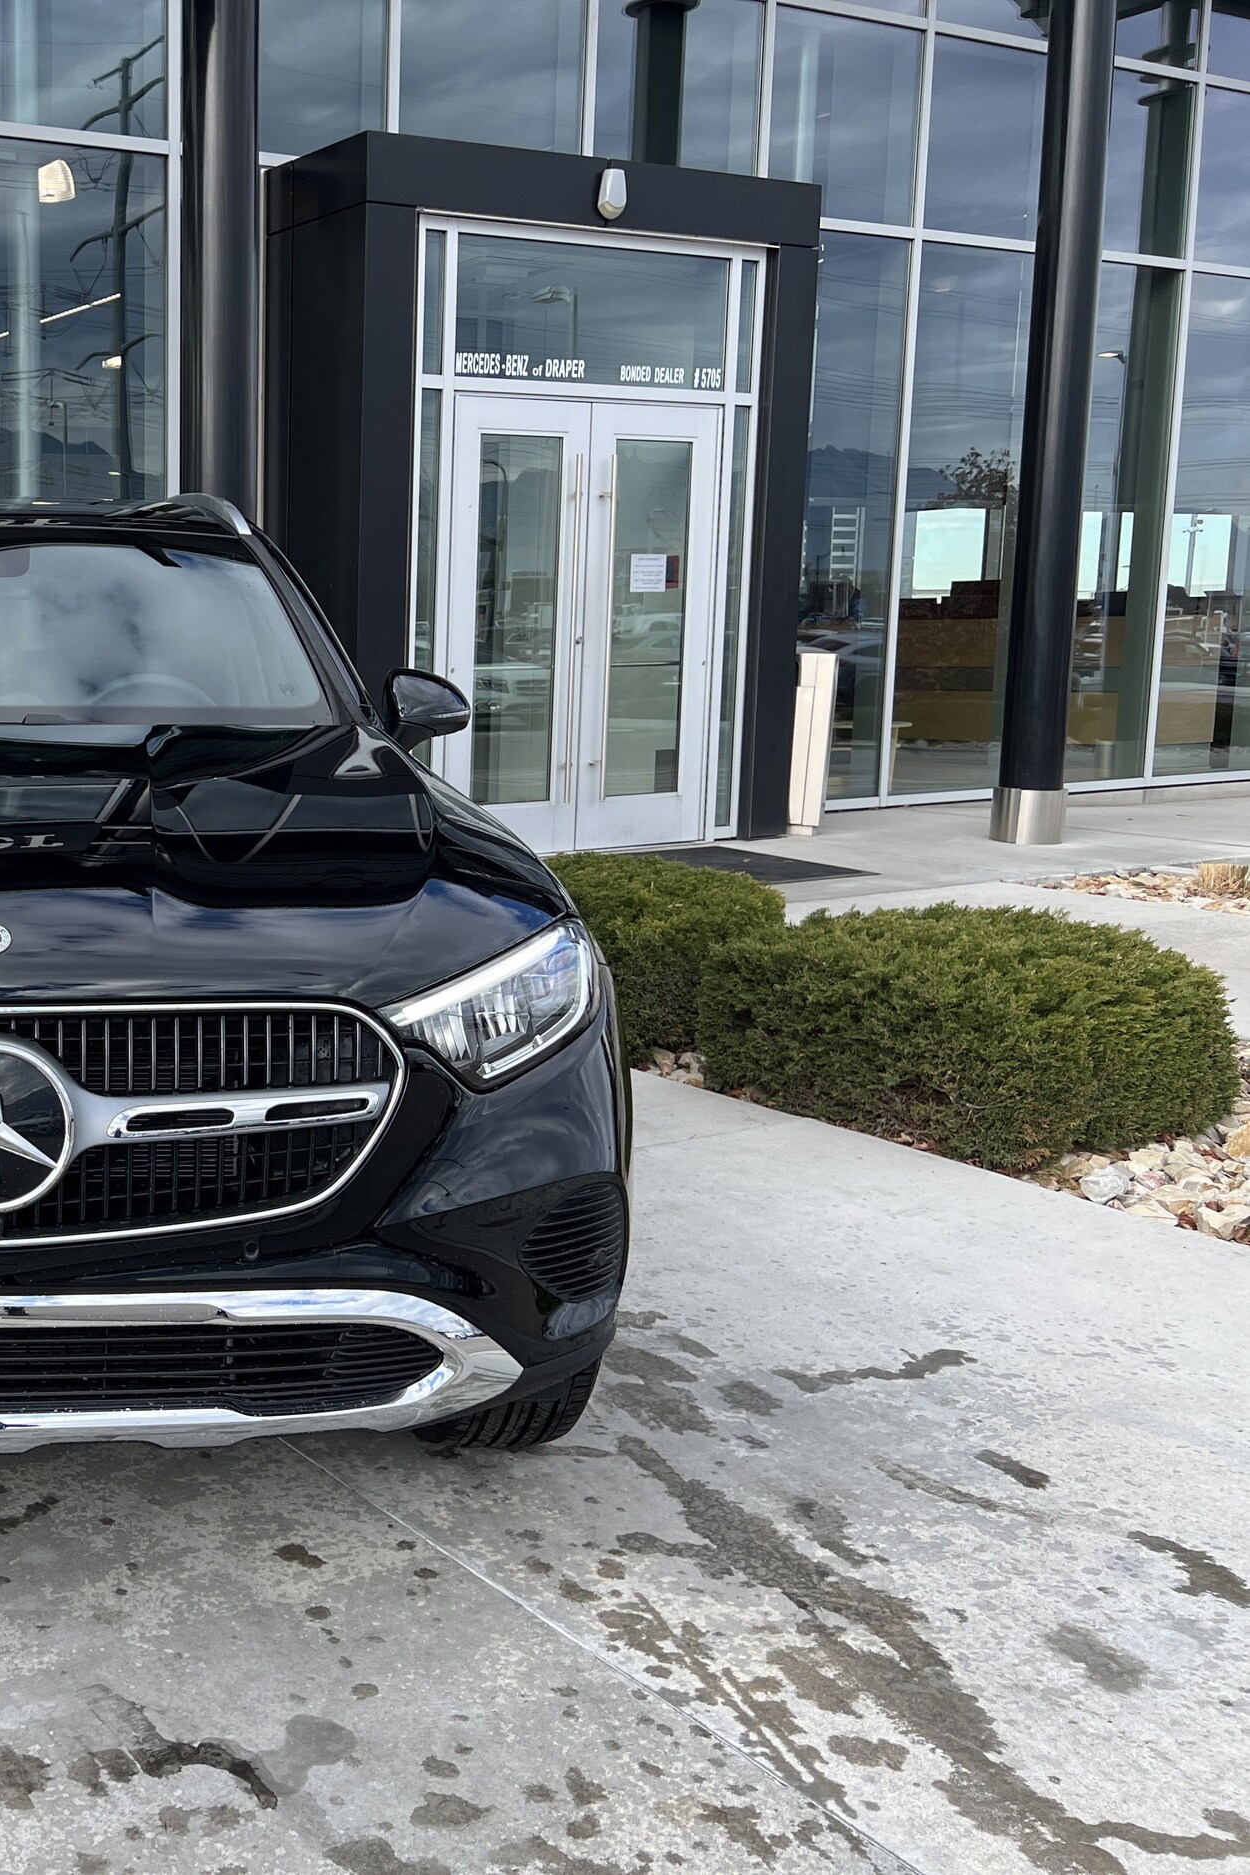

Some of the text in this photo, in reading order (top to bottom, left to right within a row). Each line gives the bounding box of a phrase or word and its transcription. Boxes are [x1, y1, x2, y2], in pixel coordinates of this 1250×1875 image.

[455, 352, 585, 379] MERCEDES-BENZ of DRAPER
[619, 365, 651, 382] BONDED
[653, 367, 685, 384] DEALER
